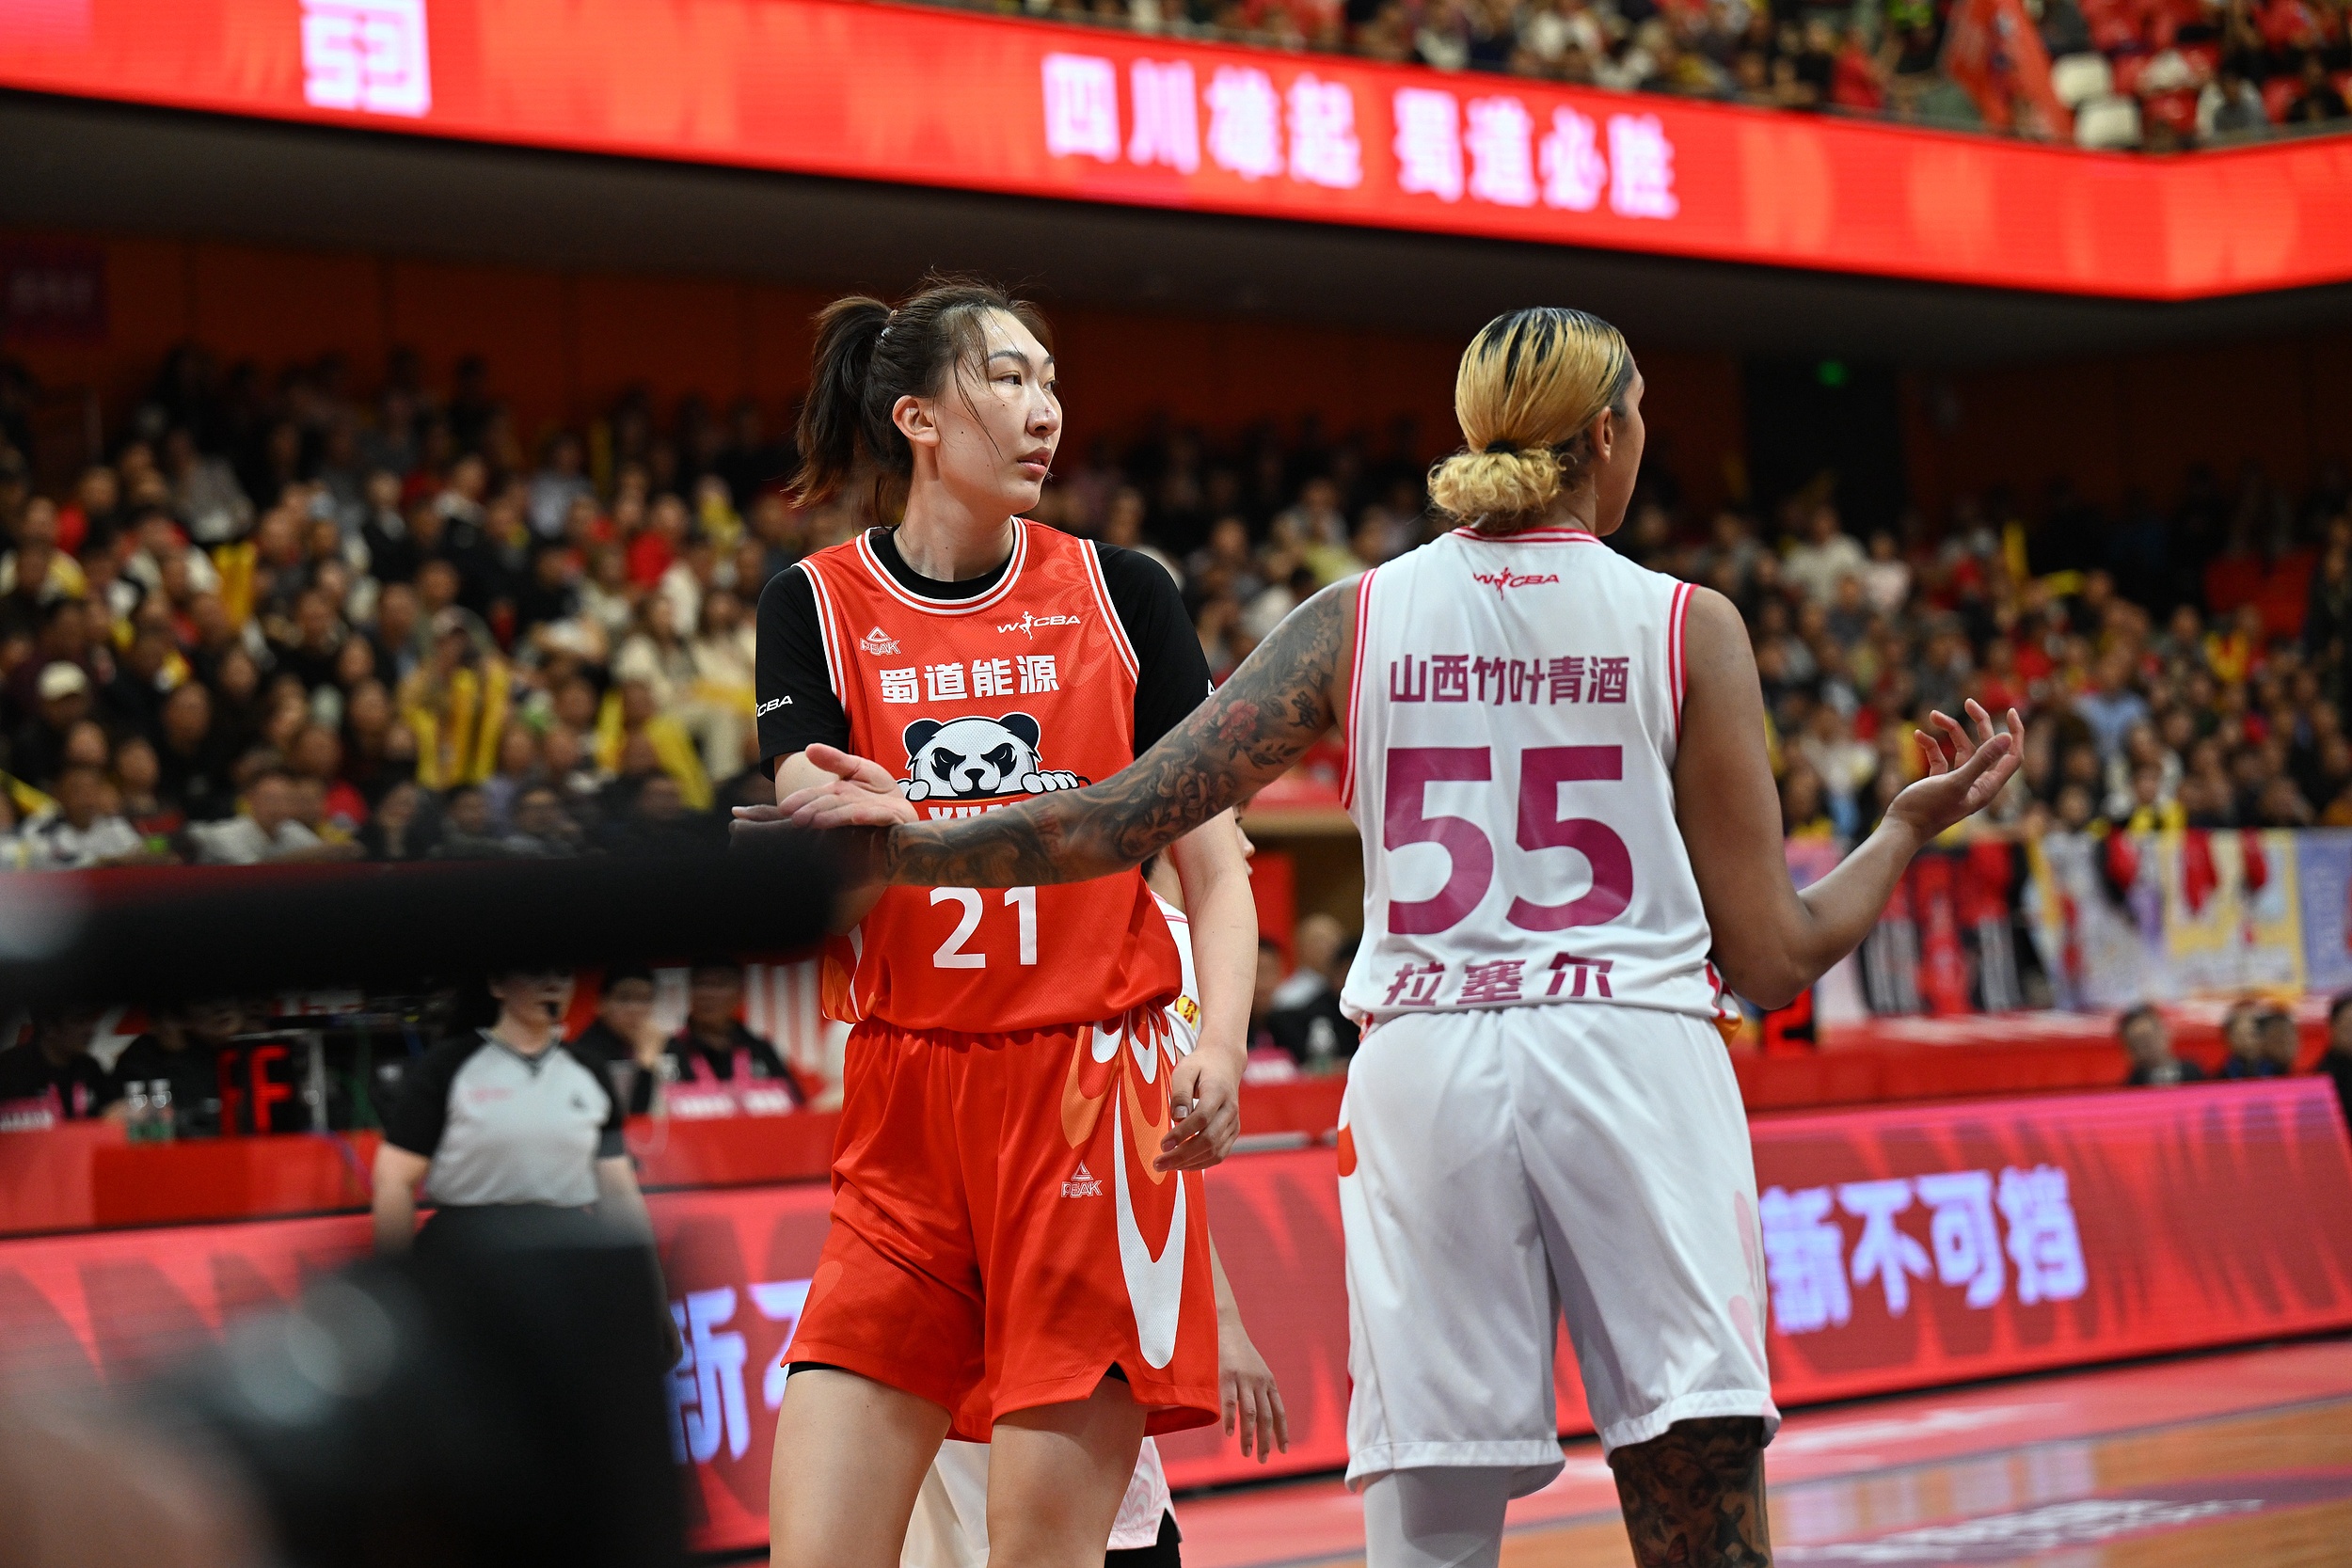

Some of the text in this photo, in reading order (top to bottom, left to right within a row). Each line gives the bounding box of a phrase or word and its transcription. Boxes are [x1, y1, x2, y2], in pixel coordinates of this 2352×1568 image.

[1041, 52, 1679, 220] 四川雄起 蜀道必胜
[860, 637, 901, 656] PEAK
[996, 614, 1081, 635] WCBA
[880, 655, 1060, 705] 蜀道能源
[1390, 654, 1629, 706] 山西竹叶青酒
[1383, 745, 1634, 935] 55
[929, 885, 1039, 969] 21
[1381, 951, 1614, 1006] 拉塞尔
[1061, 1180, 1103, 1198] PEAK
[1758, 1163, 2089, 1336] 新不可挡
